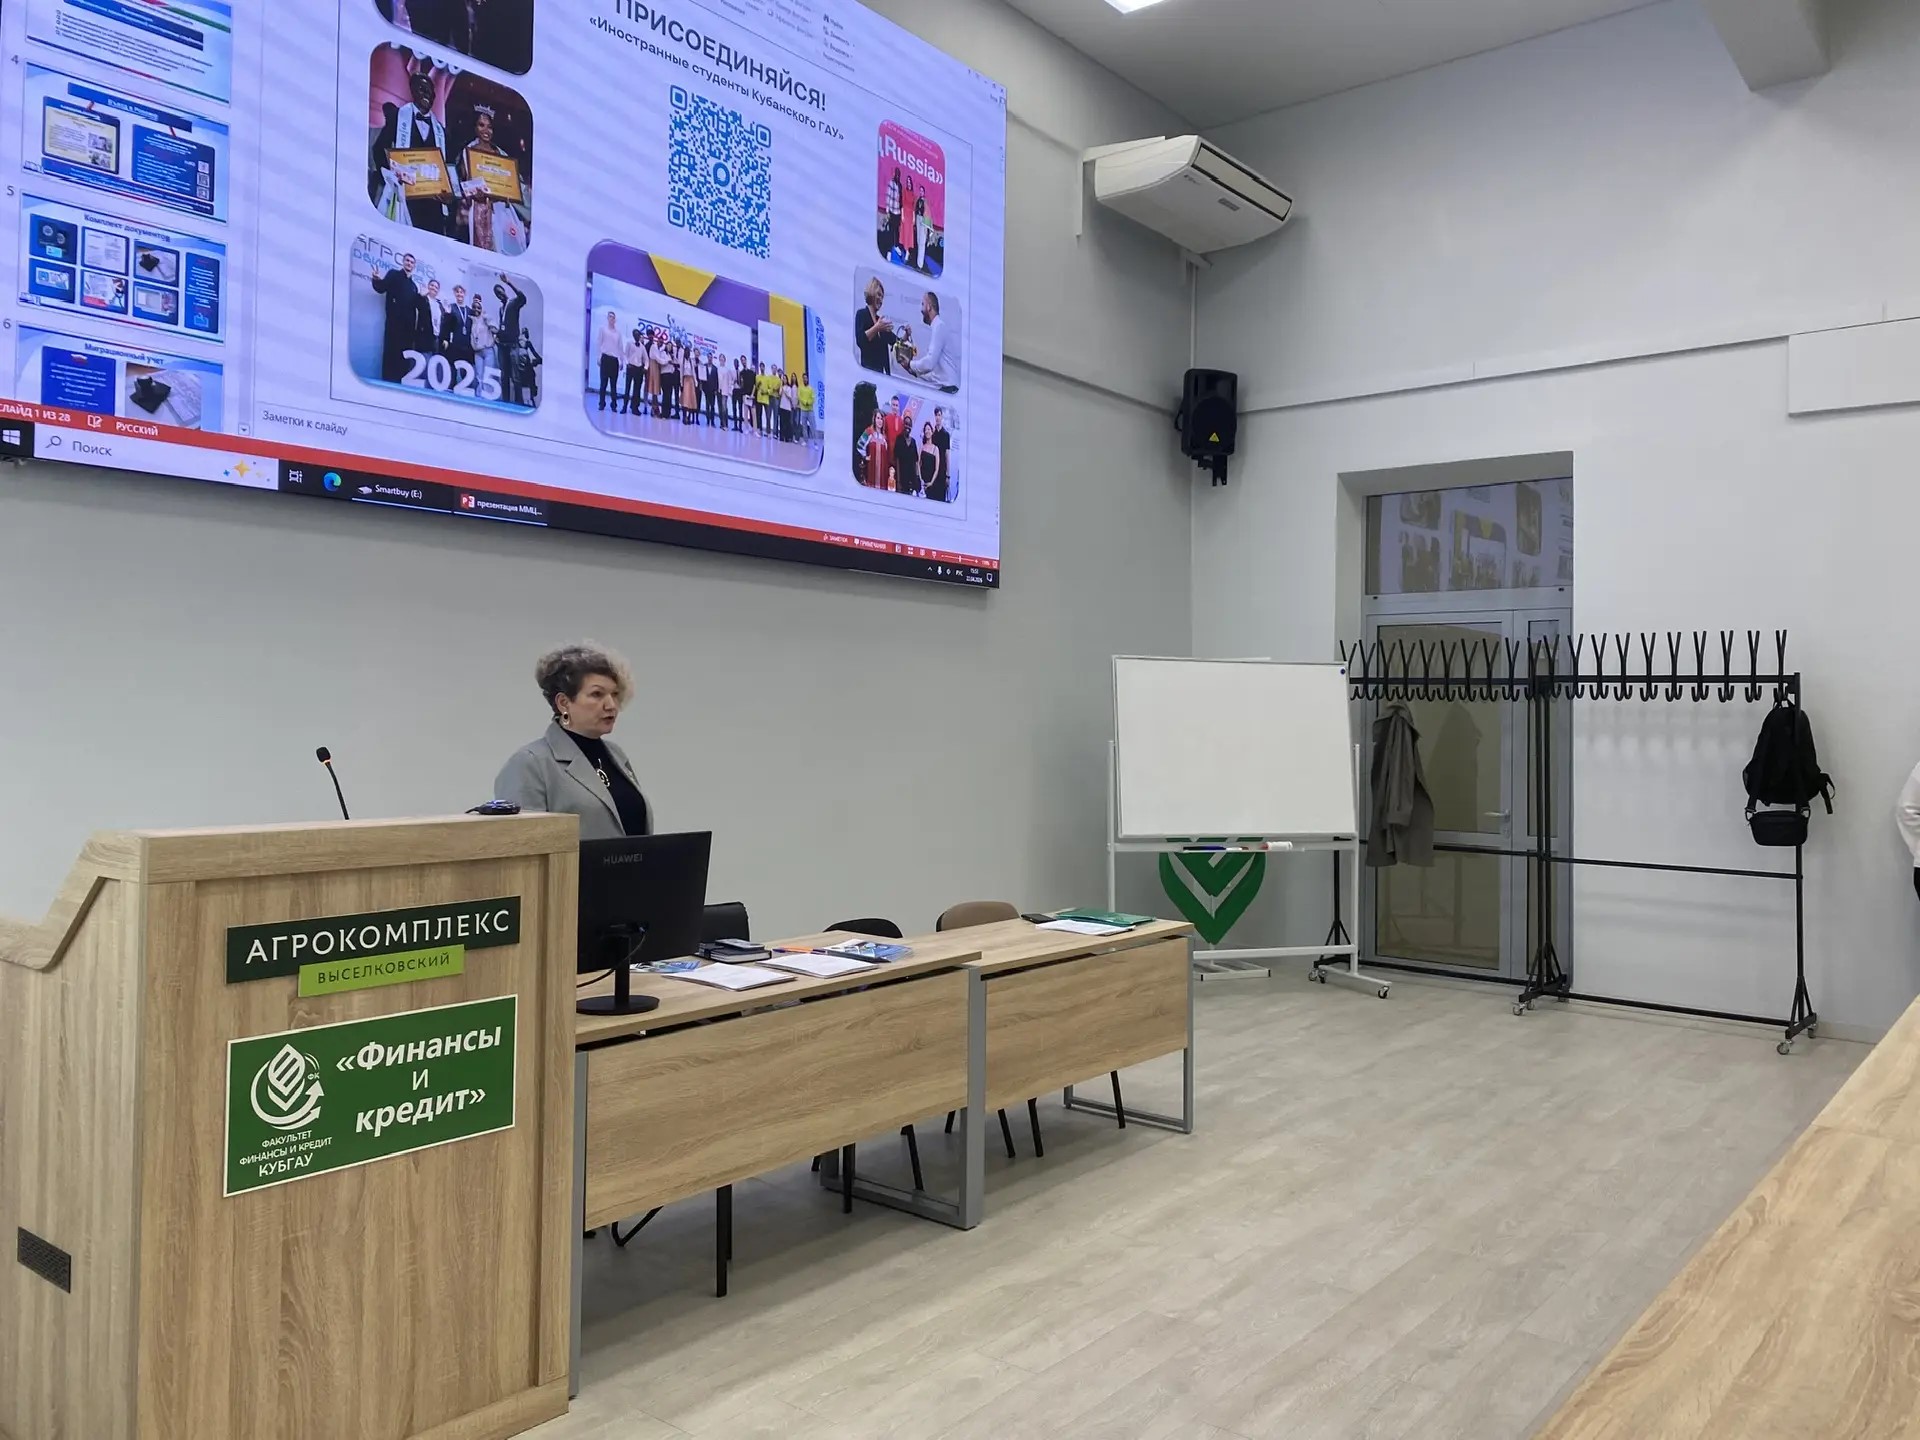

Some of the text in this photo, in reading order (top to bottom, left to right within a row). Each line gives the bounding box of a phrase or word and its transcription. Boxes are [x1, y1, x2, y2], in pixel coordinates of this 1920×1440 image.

[10, 54, 19, 65] 4
[589, 16, 689, 69] «Иностранные
[692, 63, 749, 97] студенты
[752, 88, 816, 129] Кубанского
[818, 122, 844, 141] ГАУ»
[6, 185, 15, 196] 5
[84, 214, 171, 243] Комплект документов
[3, 318, 11, 329] 6
[85, 343, 145, 360] Миграционный
[401, 350, 502, 400] 2025
[34, 410, 39, 418] 1
[43, 410, 56, 419] ИЗ
[58, 413, 71, 421] 28
[263, 410, 347, 436] Заметки к слайду
[116, 422, 158, 435] РУССКИЙ
[73, 441, 112, 456] Поиск
[375, 484, 409, 498] Smartbuy
[477, 501, 518, 512] презентация
[603, 853, 643, 865] HUAWEI
[245, 909, 510, 965] АГРОКОМПЛЕКС
[317, 951, 451, 984] ВЫСЕЛКОВСКИЙ
[336, 1026, 502, 1072] «Финансы
[355, 1087, 486, 1138] кредит»
[262, 1130, 312, 1148] ФАКУЛЬТЕТ
[239, 1137, 333, 1165] ФИНАНСЫ И КРЕДИТ
[259, 1152, 314, 1177] КУБГАУ
